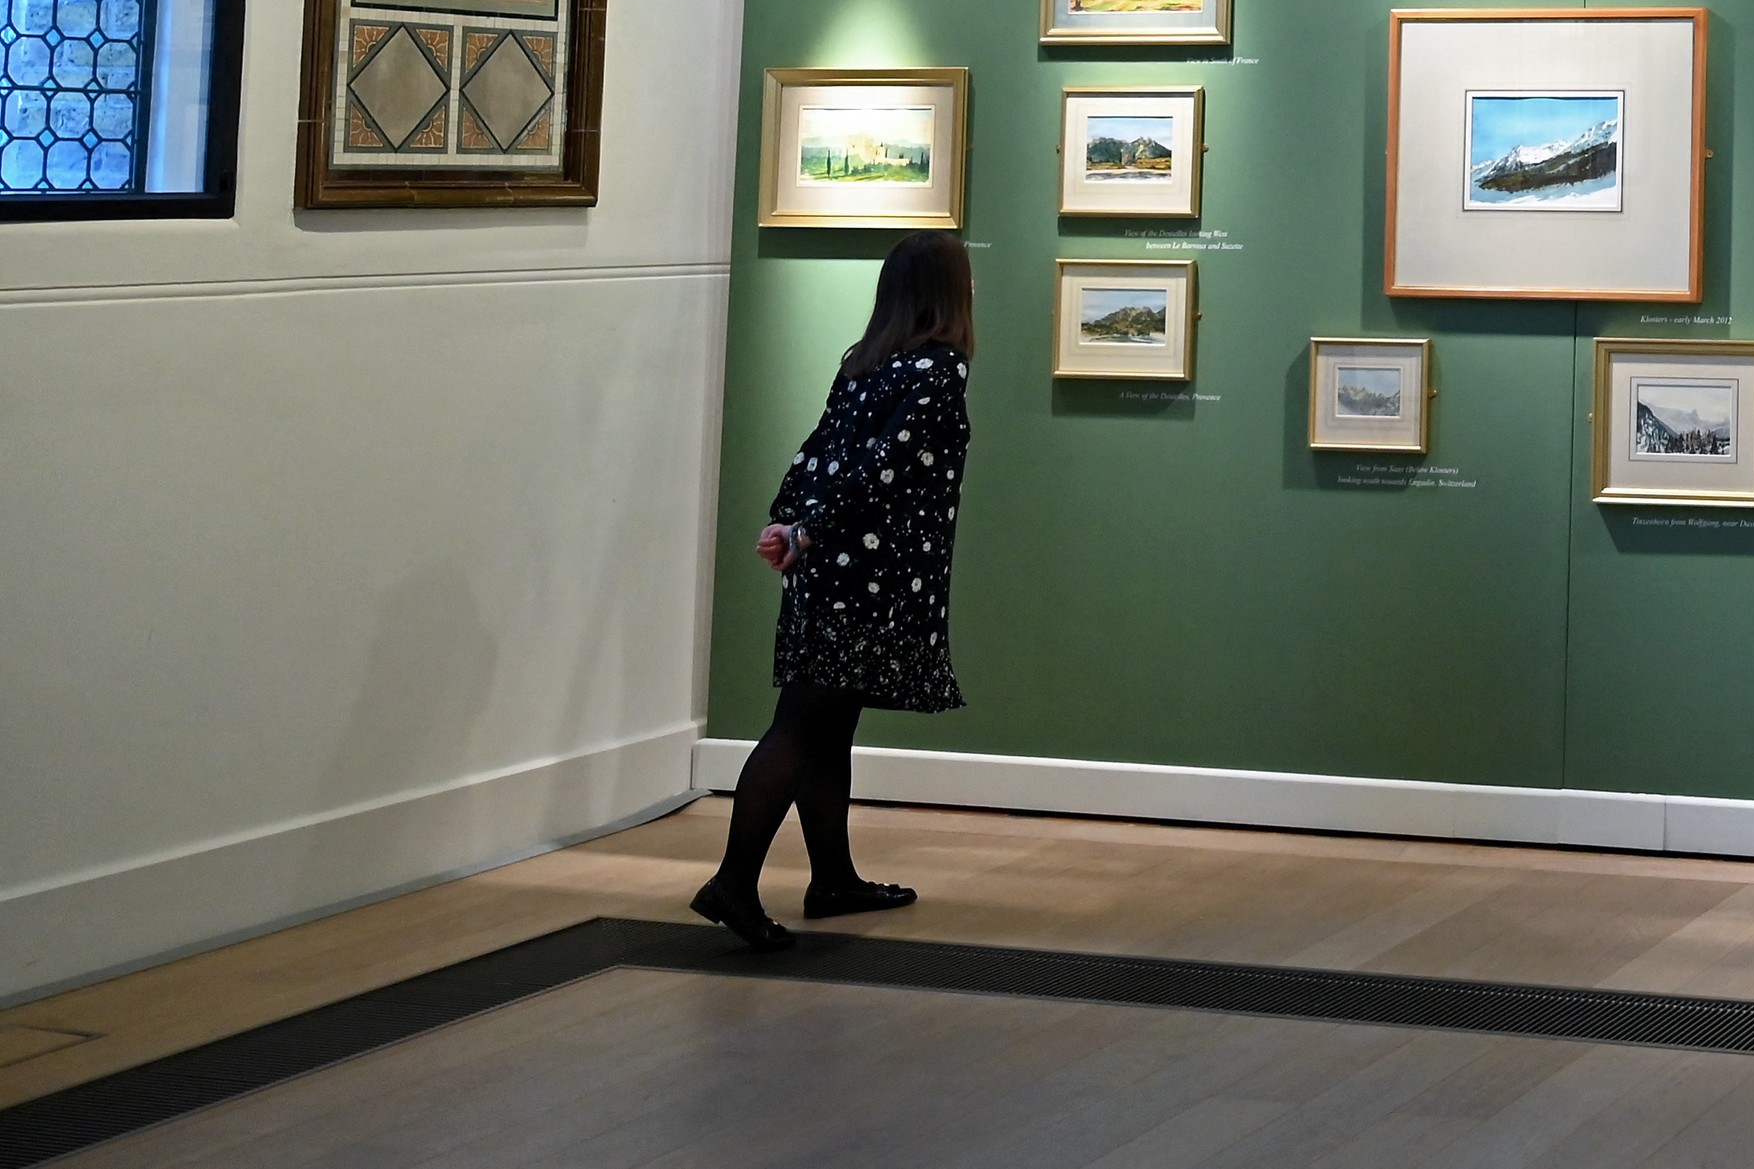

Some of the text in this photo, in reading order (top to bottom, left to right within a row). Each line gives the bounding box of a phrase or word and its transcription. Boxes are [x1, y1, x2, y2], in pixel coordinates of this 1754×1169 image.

[1236, 57, 1259, 65] France
[1146, 241, 1171, 250] between
[1172, 241, 1180, 250] Le
[1207, 241, 1221, 250] and
[1640, 315, 1667, 323] Klosters
[1673, 316, 1690, 325] early
[1693, 316, 1715, 324] March
[1715, 316, 1733, 325] 2012
[1192, 393, 1221, 401] Provence
[1429, 466, 1459, 474] Klosters)
[1438, 479, 1477, 487] Switzerland
